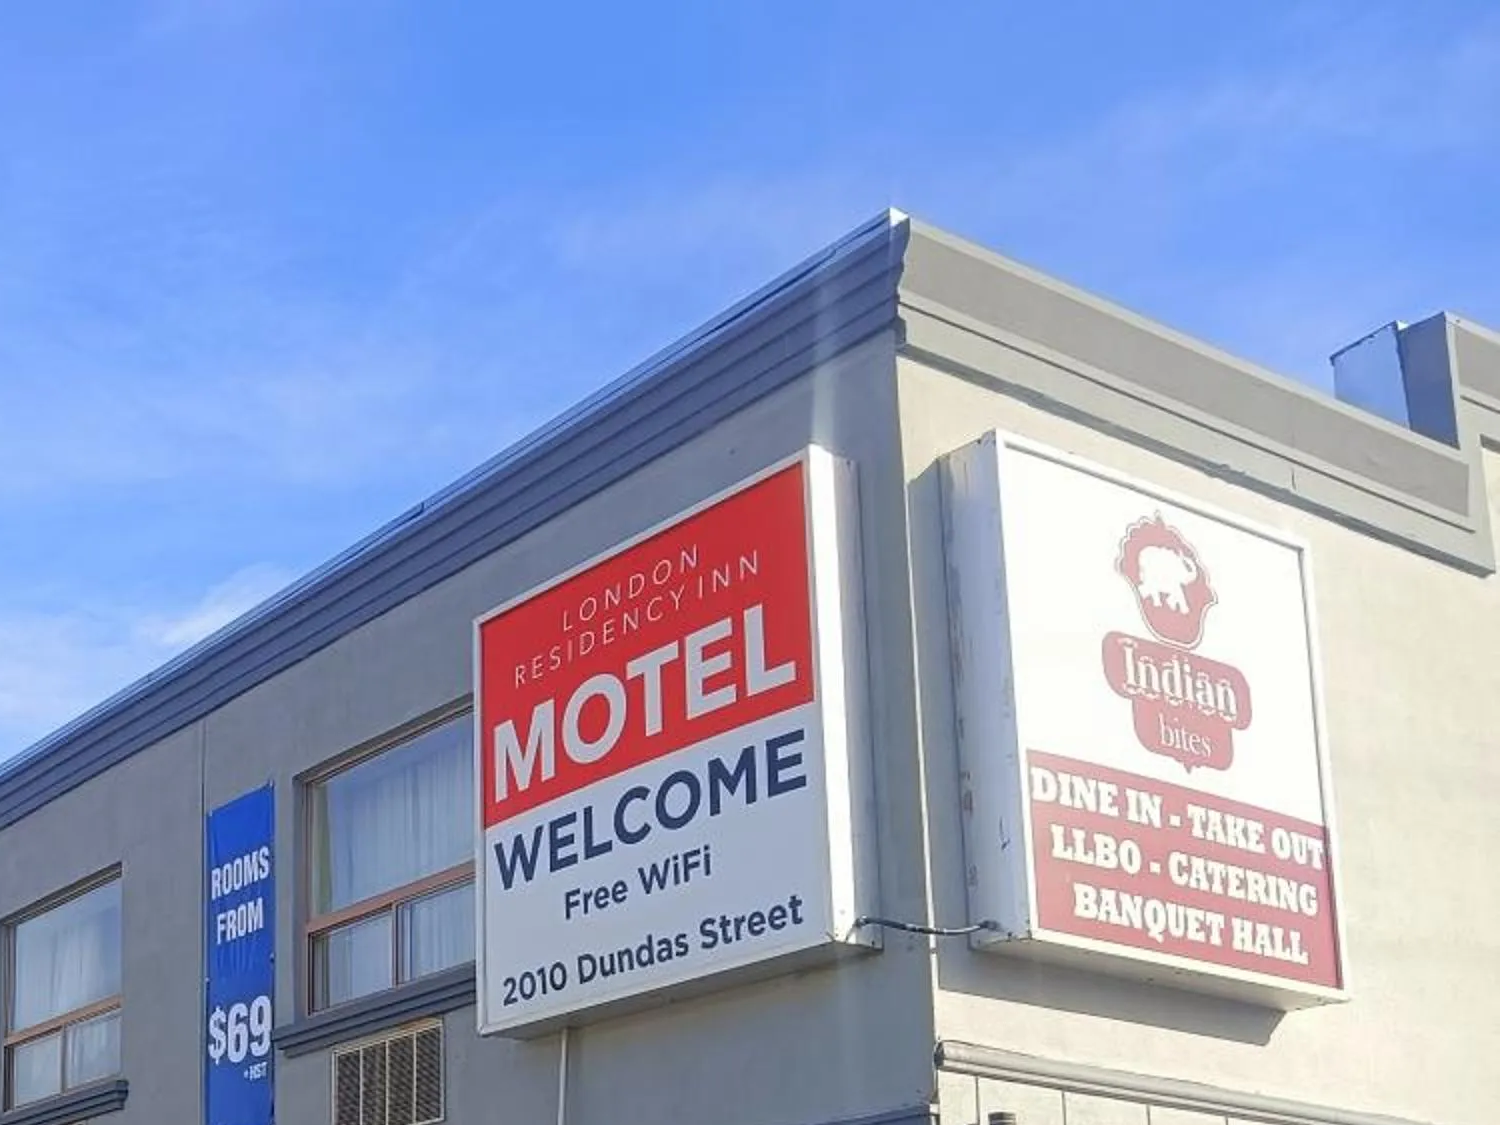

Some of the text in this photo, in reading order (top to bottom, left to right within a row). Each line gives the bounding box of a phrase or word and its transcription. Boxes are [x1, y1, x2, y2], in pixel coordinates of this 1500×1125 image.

[514, 551, 759, 690] RESIDENCY INN
[562, 545, 699, 632] LONDON
[493, 604, 797, 803] MOTEL
[1121, 641, 1238, 722] Indian
[1158, 717, 1213, 759] bites
[494, 728, 808, 891] WELCOME
[1032, 766, 1119, 817] DINE
[1125, 789, 1163, 829] IN
[1187, 804, 1266, 855] TAKE
[1271, 825, 1326, 870] OUT
[210, 846, 271, 900] ROOMS
[564, 844, 713, 921] Free WiFi
[1051, 824, 1142, 875] LLBO
[1169, 853, 1318, 917] CATERING
[216, 897, 264, 945] FROM
[503, 895, 804, 1006] 2010 Dundas Street
[1073, 882, 1309, 965] BANQUET HALL
[207, 995, 273, 1066] $69
